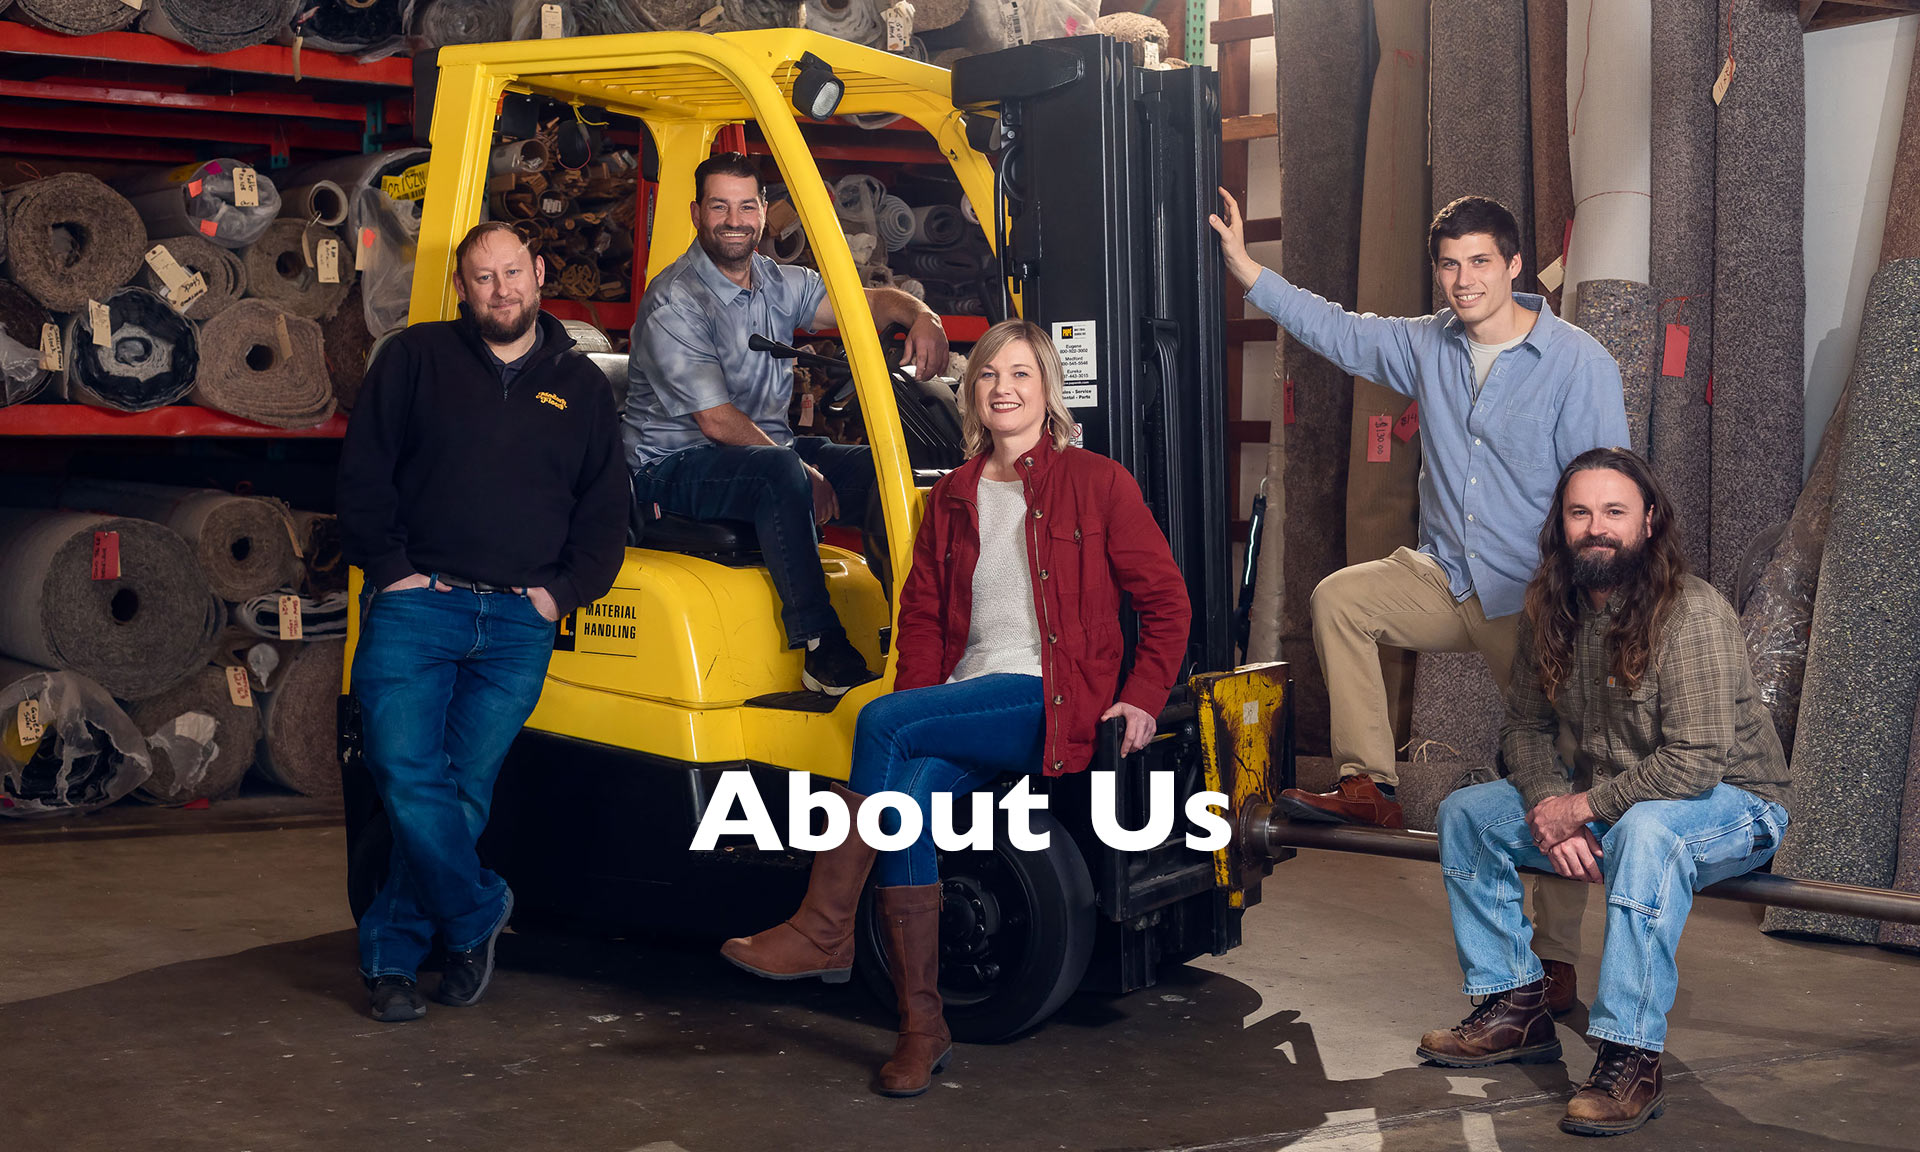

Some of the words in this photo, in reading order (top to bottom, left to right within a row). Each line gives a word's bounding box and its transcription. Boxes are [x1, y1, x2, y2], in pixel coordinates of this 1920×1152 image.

[1065, 343, 1082, 351] Eugene
[586, 603, 636, 619] MATERIAL
[584, 622, 636, 639] HANDLING
